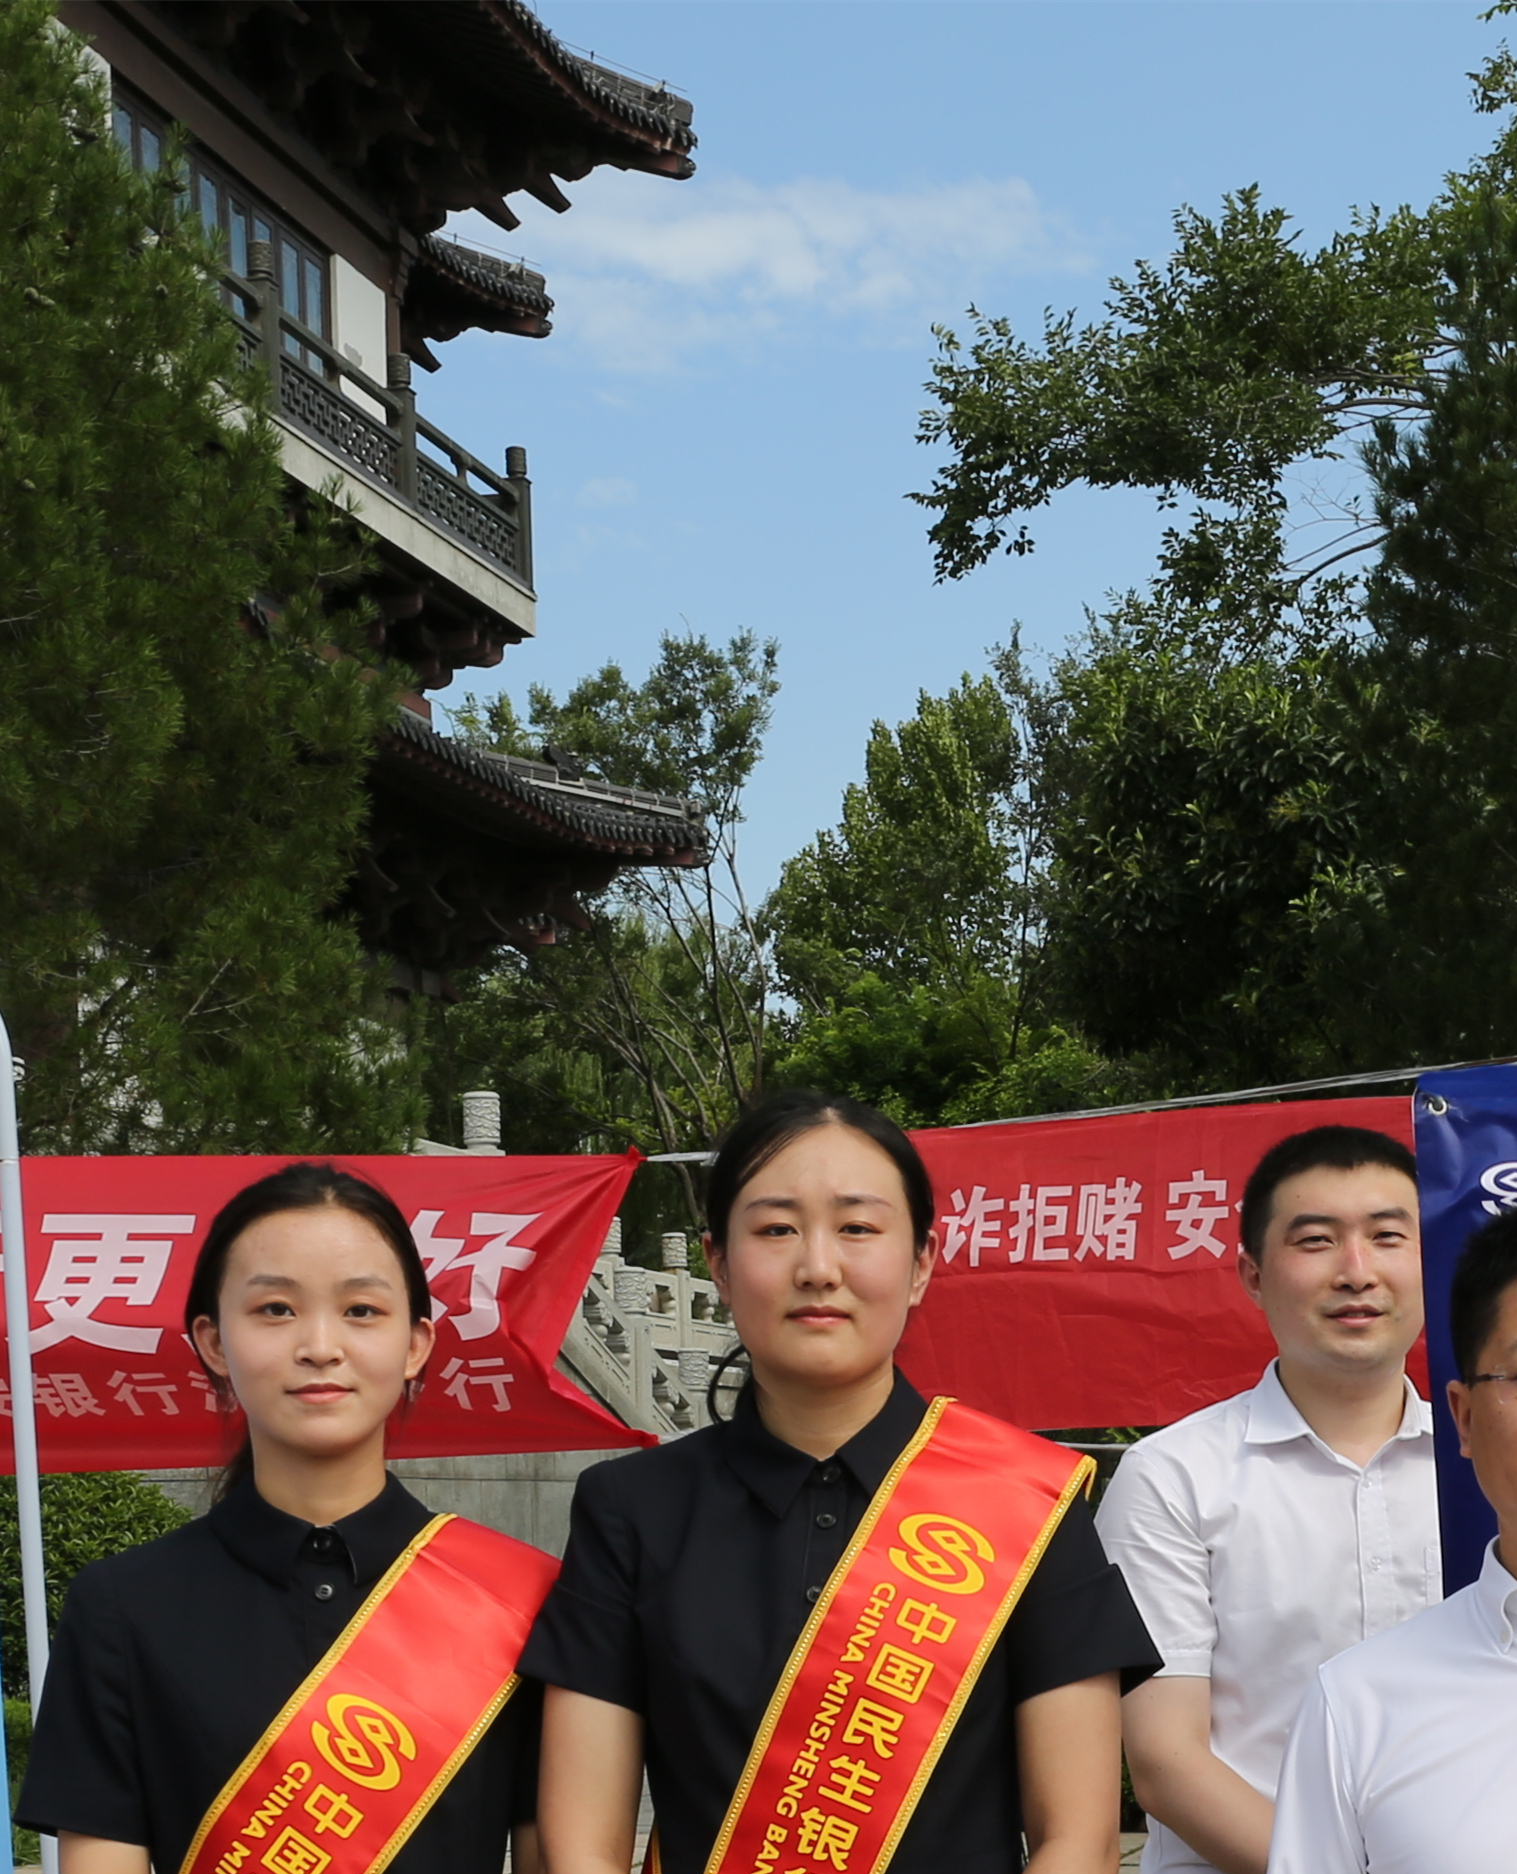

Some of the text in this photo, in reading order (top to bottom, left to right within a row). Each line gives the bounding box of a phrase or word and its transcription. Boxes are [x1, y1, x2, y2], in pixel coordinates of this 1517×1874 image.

[940, 1170, 1246, 1267] 诈拒赌 安
[840, 1580, 897, 1664] CHINA
[773, 1669, 856, 1820] MINSHENG
[247, 1760, 314, 1841] CHINA
